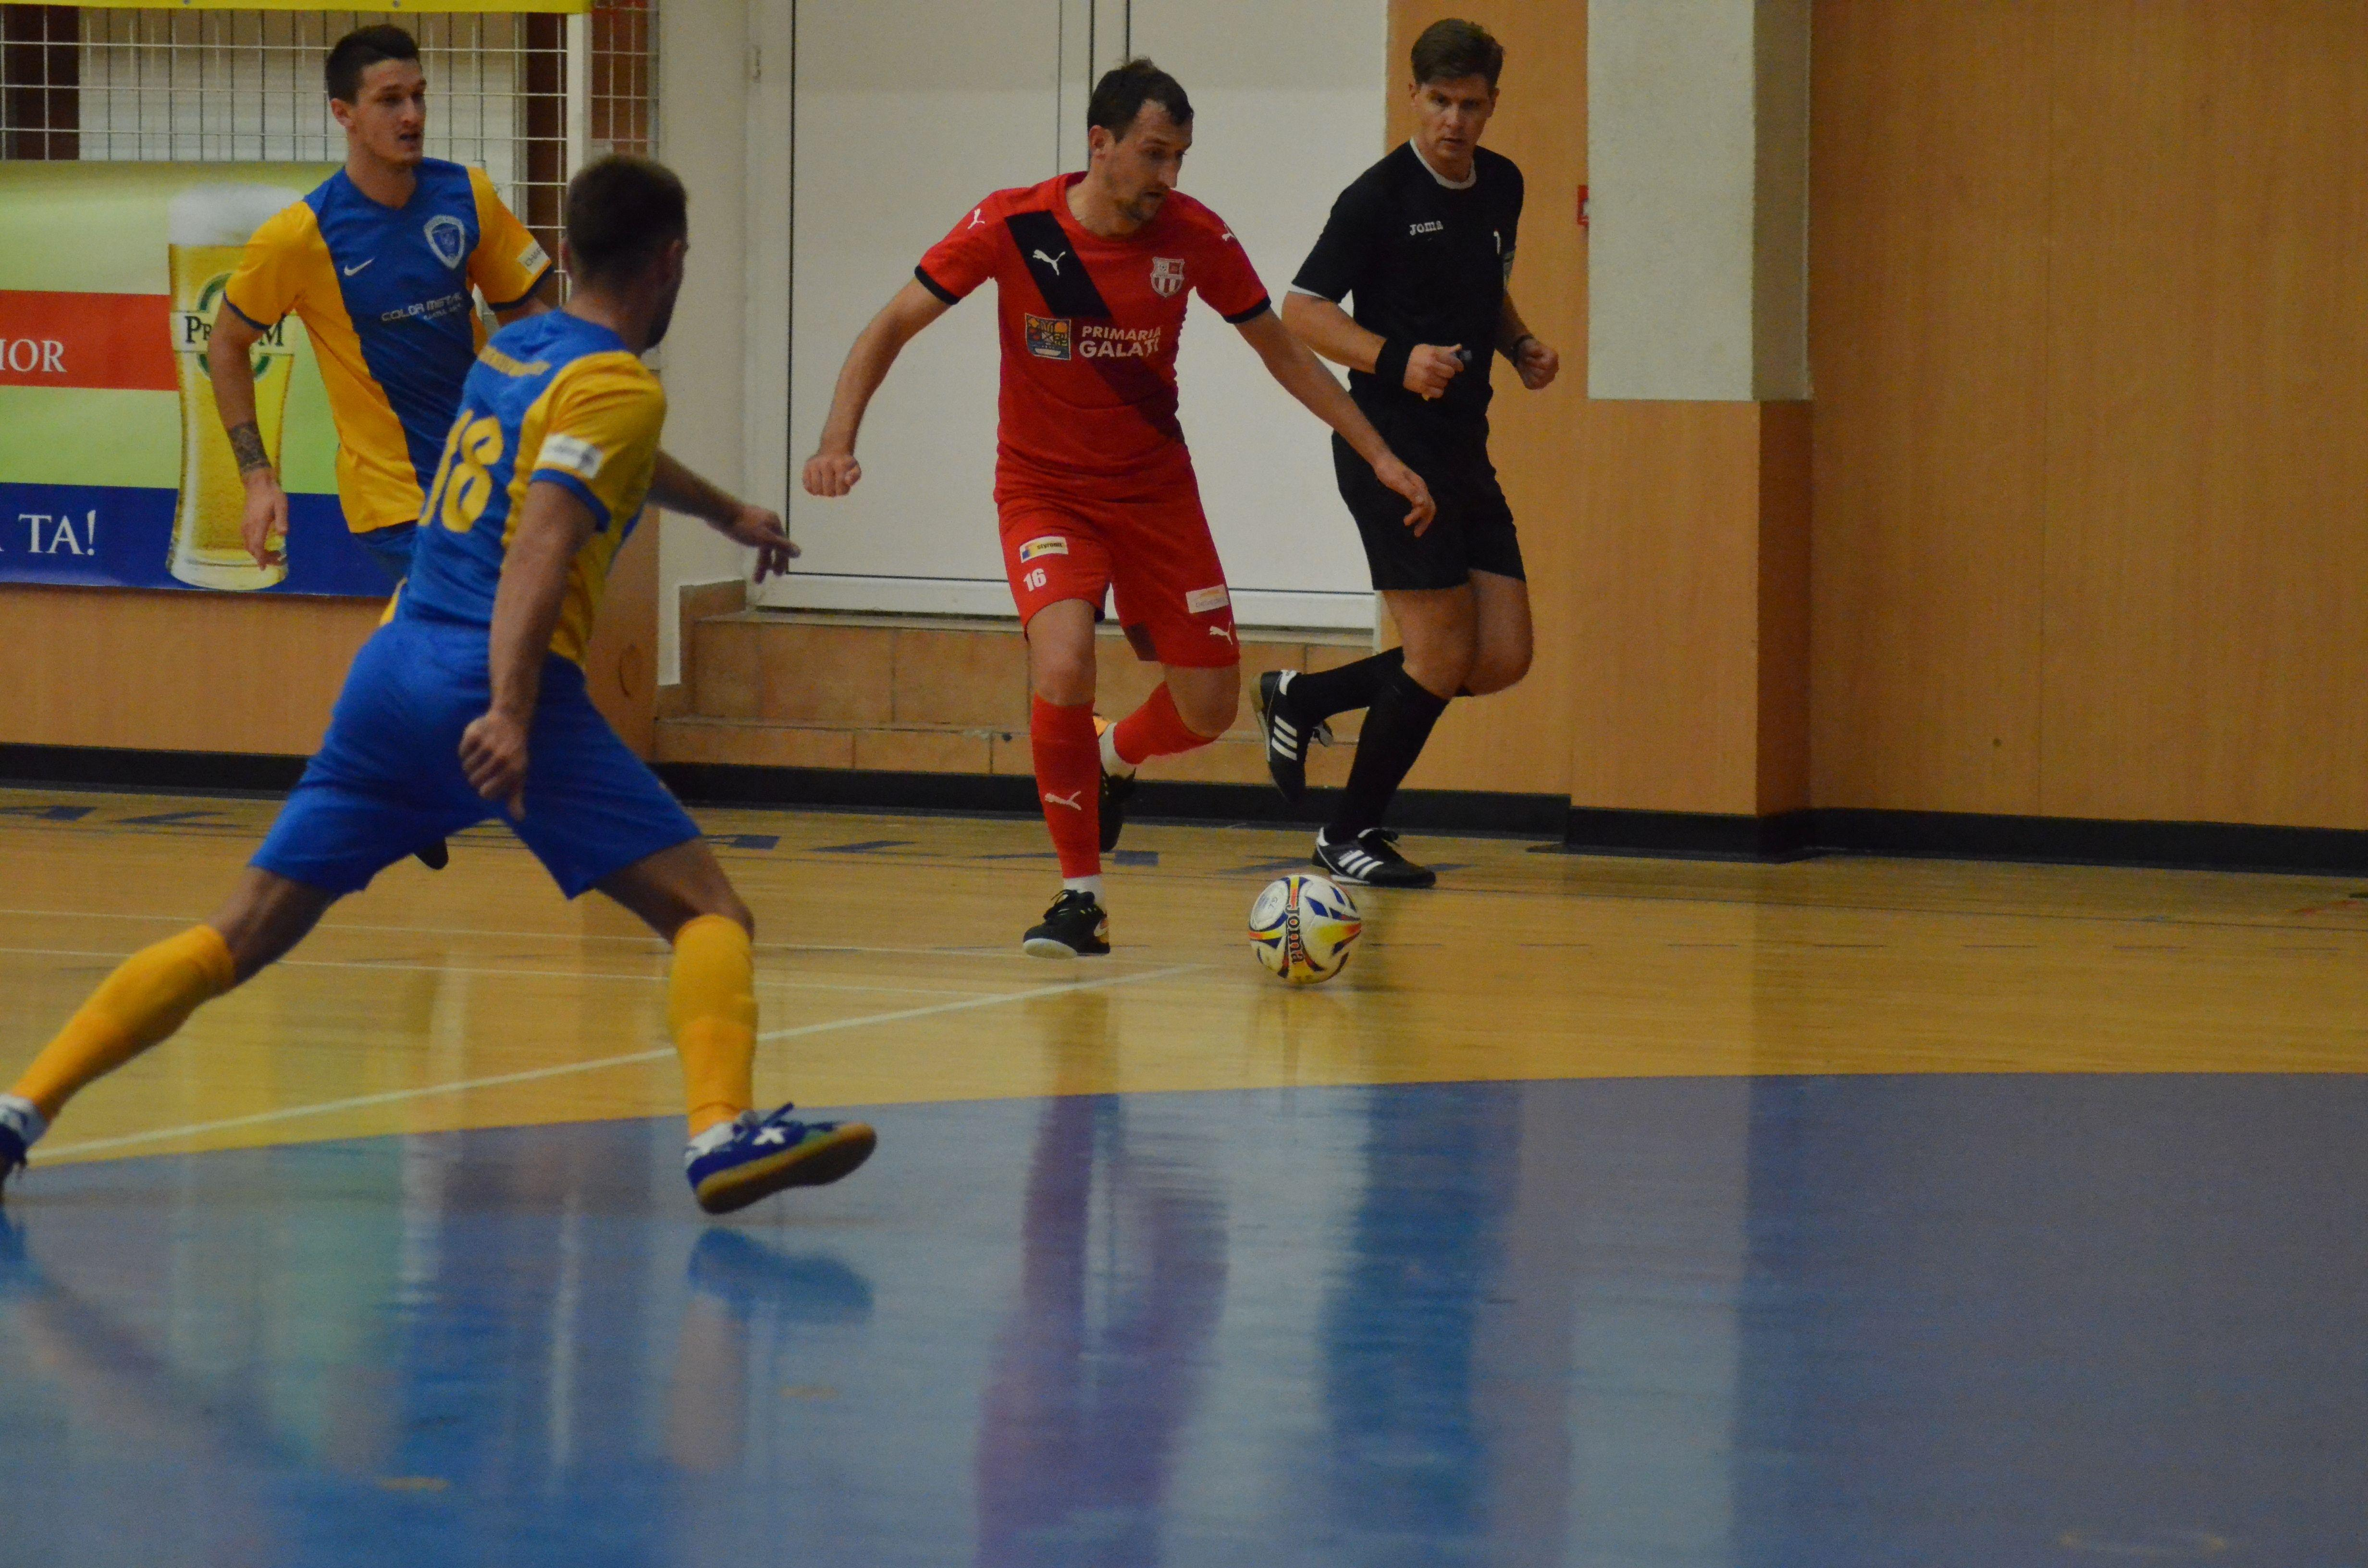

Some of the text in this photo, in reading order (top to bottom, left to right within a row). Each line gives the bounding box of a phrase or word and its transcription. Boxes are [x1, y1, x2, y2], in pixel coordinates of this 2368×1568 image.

[418, 409, 504, 533] 18
[18, 509, 96, 556] TA!
[1023, 568, 1047, 592] 16
